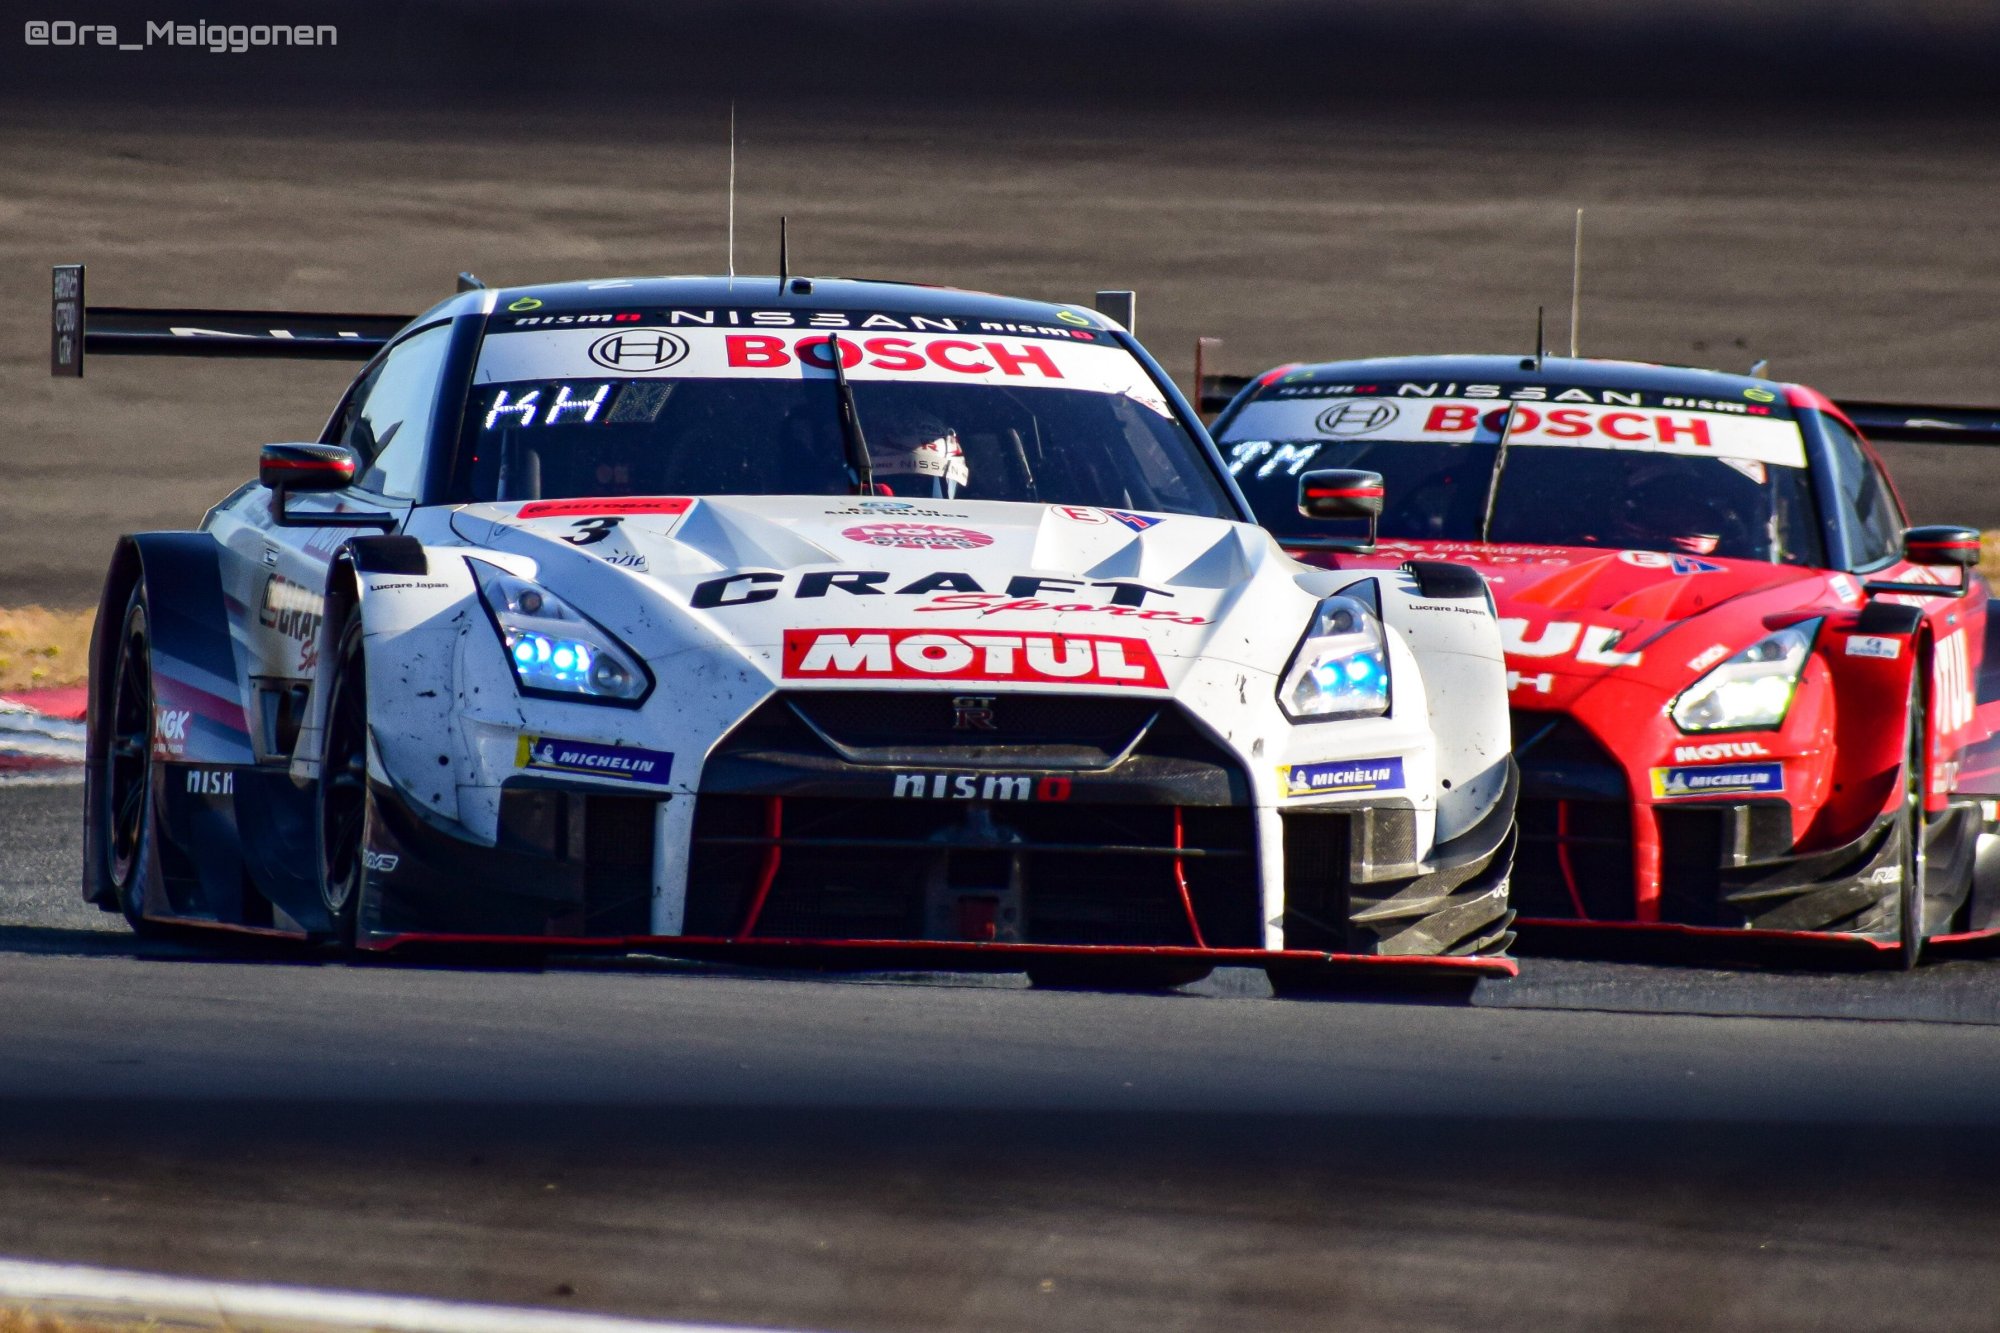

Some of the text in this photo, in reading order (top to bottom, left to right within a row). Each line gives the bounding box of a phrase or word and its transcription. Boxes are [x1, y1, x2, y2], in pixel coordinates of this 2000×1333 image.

[515, 313, 641, 326] nismo
[670, 310, 959, 331] NISSAN
[980, 321, 1094, 341] nismo
[725, 334, 1064, 379] BOSCH
[1398, 382, 1641, 407] NISSAN
[1662, 397, 1771, 415] nismo
[1423, 403, 1712, 447] BOSCH
[560, 517, 625, 546] 3
[860, 527, 966, 537] NGK
[370, 583, 413, 592] Lucrare
[689, 571, 1175, 608] CRAFT
[913, 594, 1217, 625] Sports
[1409, 604, 1485, 616] Lucrare Japan
[799, 633, 1146, 680] MOTUL
[558, 751, 655, 772] MICHELIN
[1675, 742, 1770, 762] MOTUL
[893, 772, 1072, 801] nismo
[1312, 766, 1391, 786] MICHELIN
[1689, 773, 1770, 787] MICHELIN
